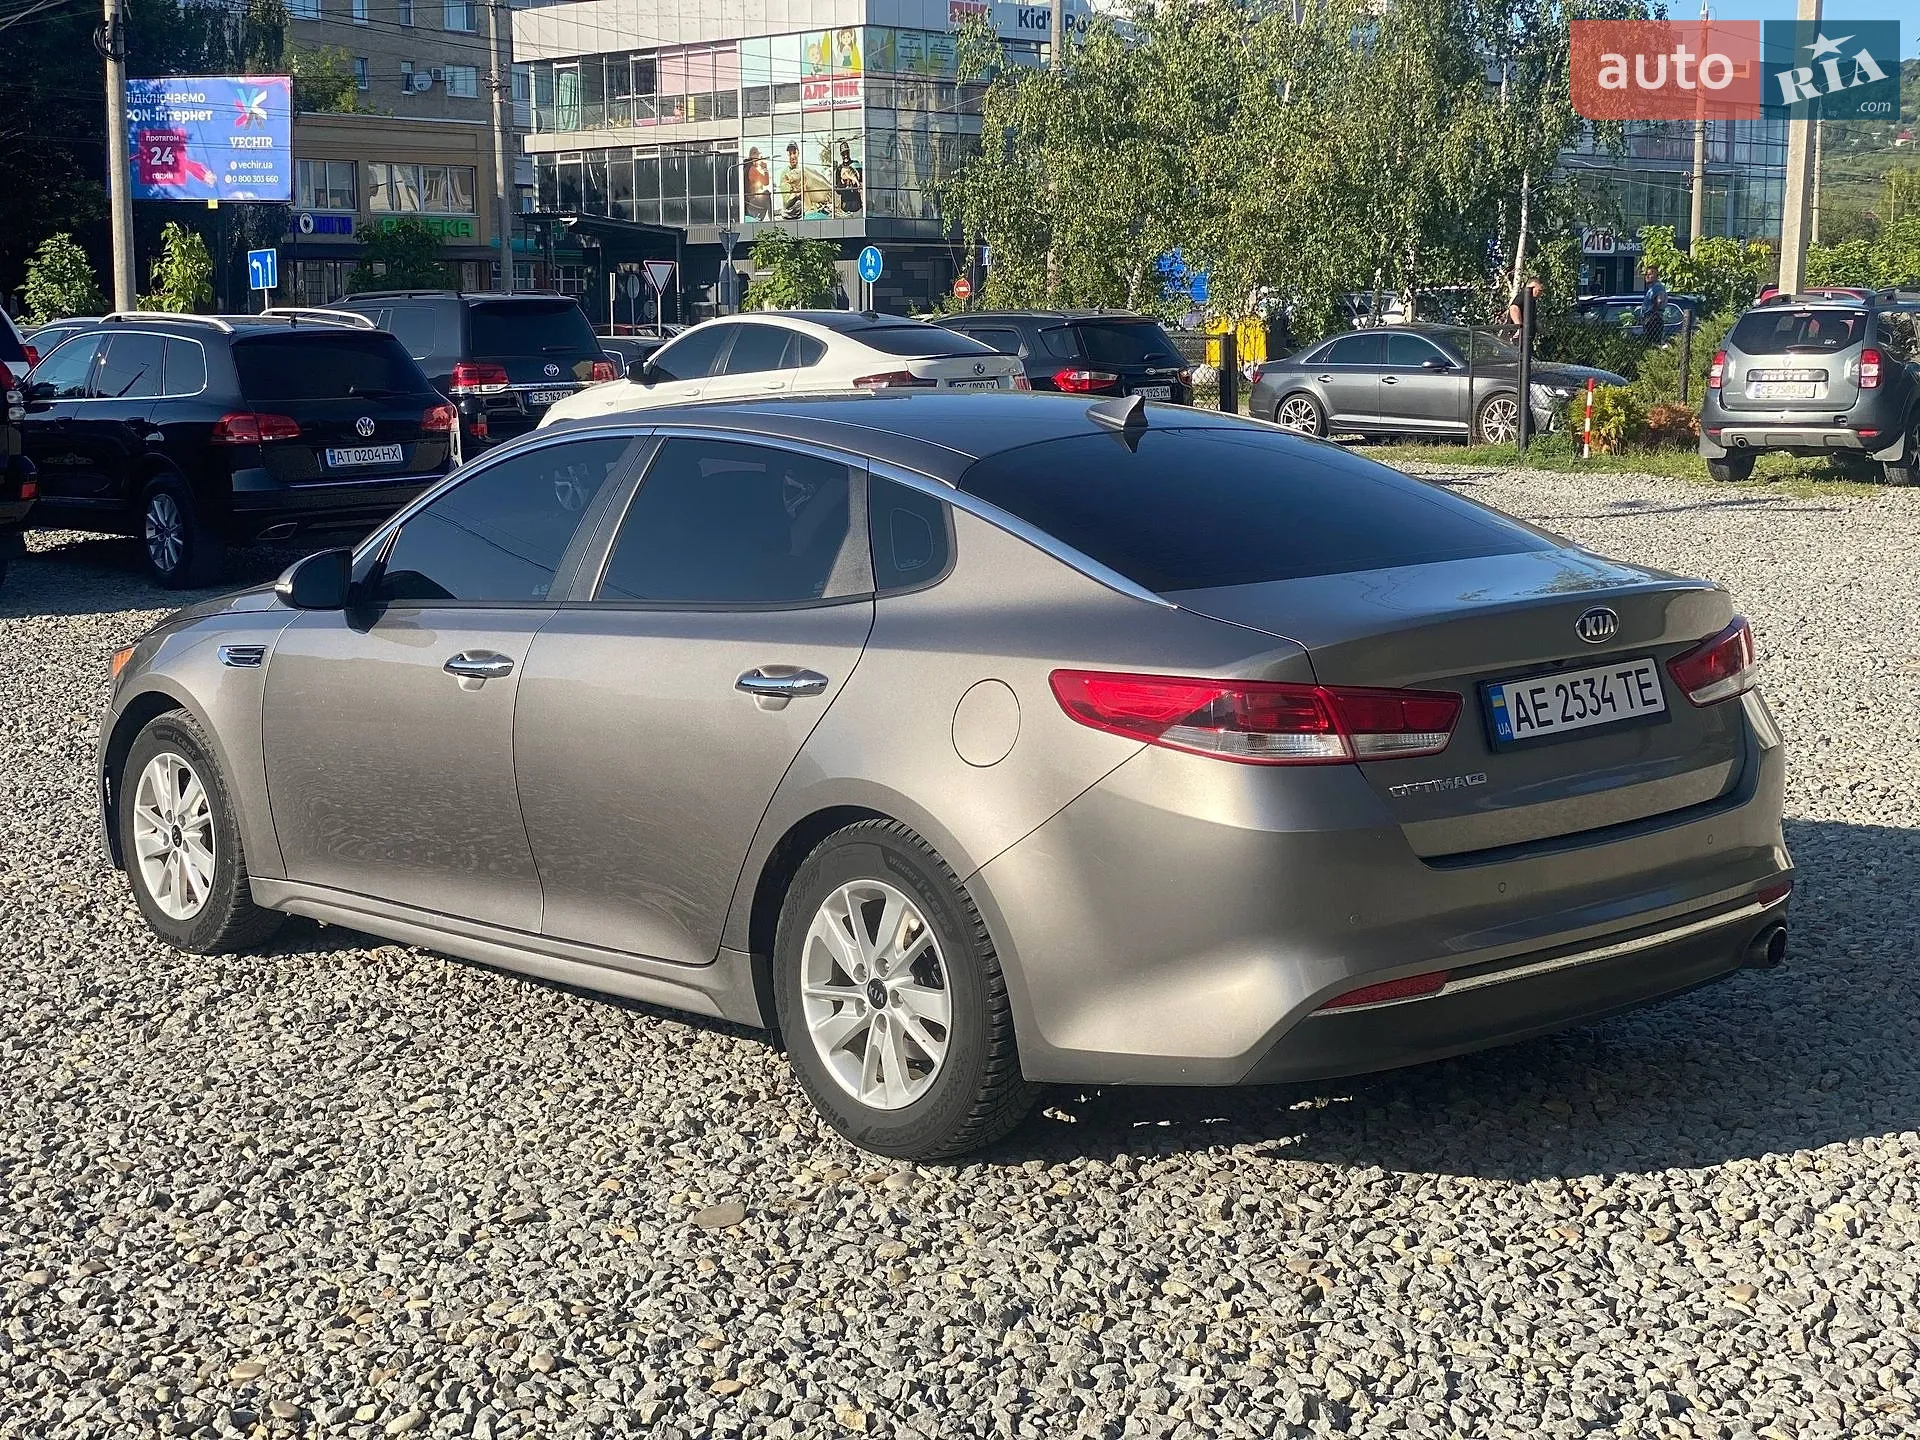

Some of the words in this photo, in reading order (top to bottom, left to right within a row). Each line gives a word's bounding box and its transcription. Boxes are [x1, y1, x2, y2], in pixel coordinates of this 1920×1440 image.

[1018, 8, 1052, 30] Kid'
[229, 136, 273, 148] VECHIR
[150, 147, 175, 166] 24
[238, 160, 273, 169] vechir.ua
[232, 175, 237, 183] 0
[238, 175, 252, 183] 800
[252, 175, 265, 183] 303
[265, 175, 279, 183] 660
[383, 217, 473, 237] АЕКА
[1618, 242, 1642, 251] МАРКЕ
[533, 392, 544, 402] CE
[544, 391, 561, 401] 5162
[336, 448, 351, 463] AT
[354, 447, 381, 462] 0204
[382, 446, 399, 461] HX
[1584, 613, 1615, 638] KIA
[1515, 687, 1554, 732] AE
[1555, 674, 1617, 724] 2534
[1616, 667, 1658, 710] TE
[1499, 722, 1512, 736] UA
[868, 986, 885, 1003] KIA
